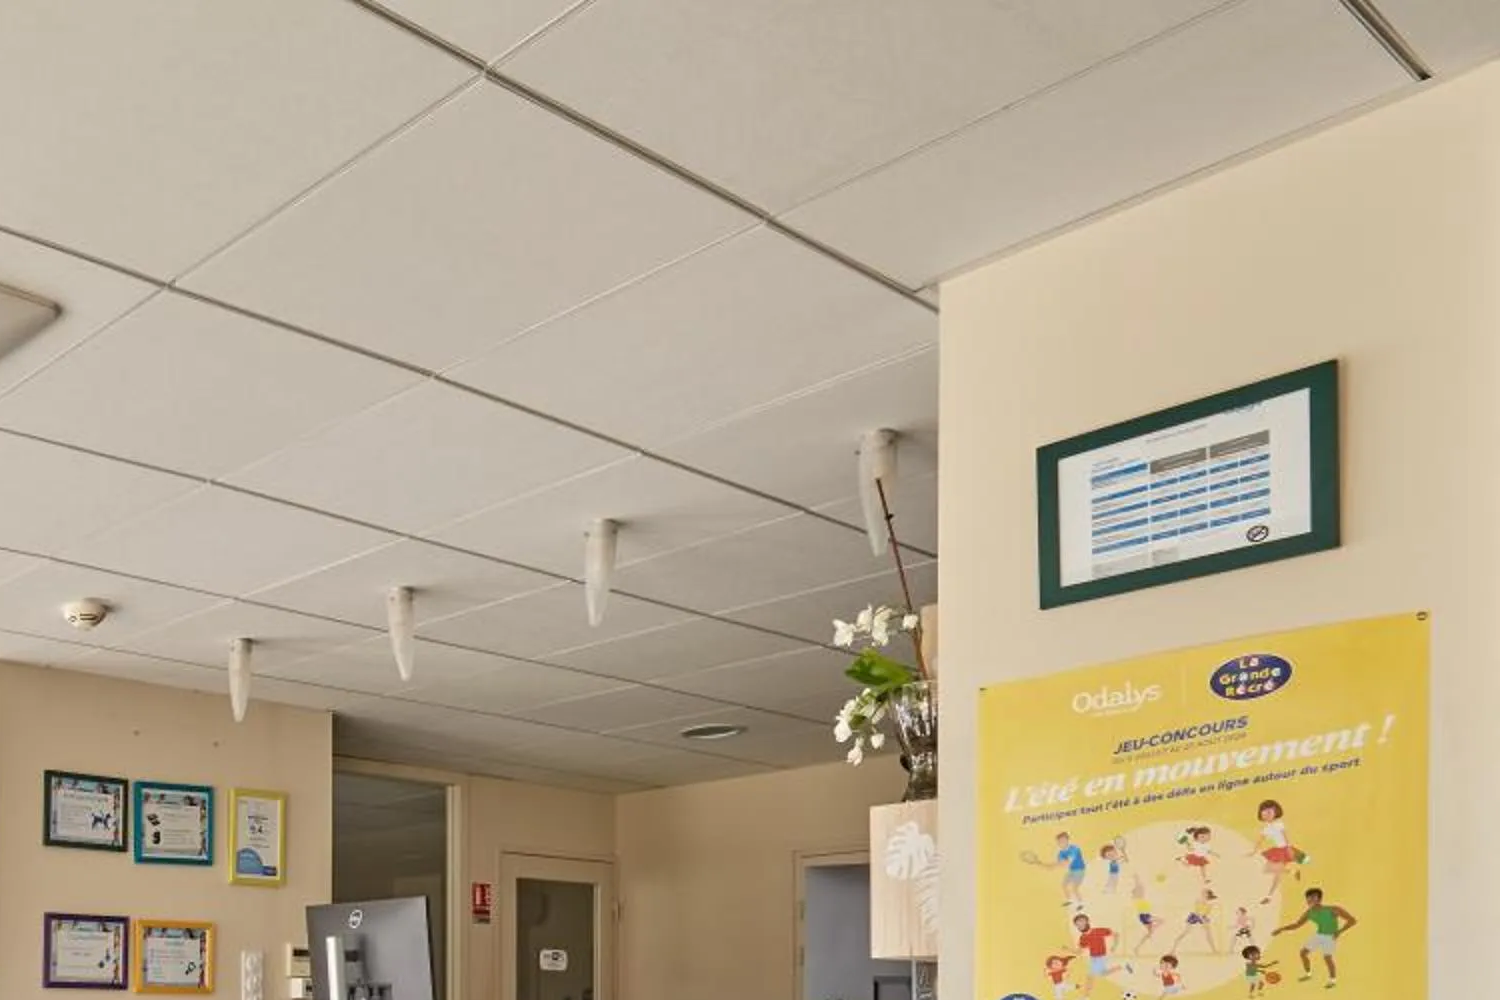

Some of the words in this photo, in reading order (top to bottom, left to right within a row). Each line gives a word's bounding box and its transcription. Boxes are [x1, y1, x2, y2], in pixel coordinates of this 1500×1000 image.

[1218, 666, 1281, 685] Grande
[1072, 680, 1162, 714] Odalys
[1113, 715, 1249, 754] JEU-CONCOURS
[1004, 774, 1079, 813] L'été
[1084, 772, 1125, 797] en
[1133, 721, 1372, 789] mouvement
[1377, 713, 1396, 745] !
[1022, 808, 1078, 825] Participez
[1079, 803, 1103, 815] tout
[1144, 793, 1164, 804] des
[1199, 784, 1215, 793] en
[1217, 777, 1250, 791] ligne
[1252, 769, 1297, 785] autour
[1300, 765, 1318, 775] du
[1322, 757, 1362, 774] sport
